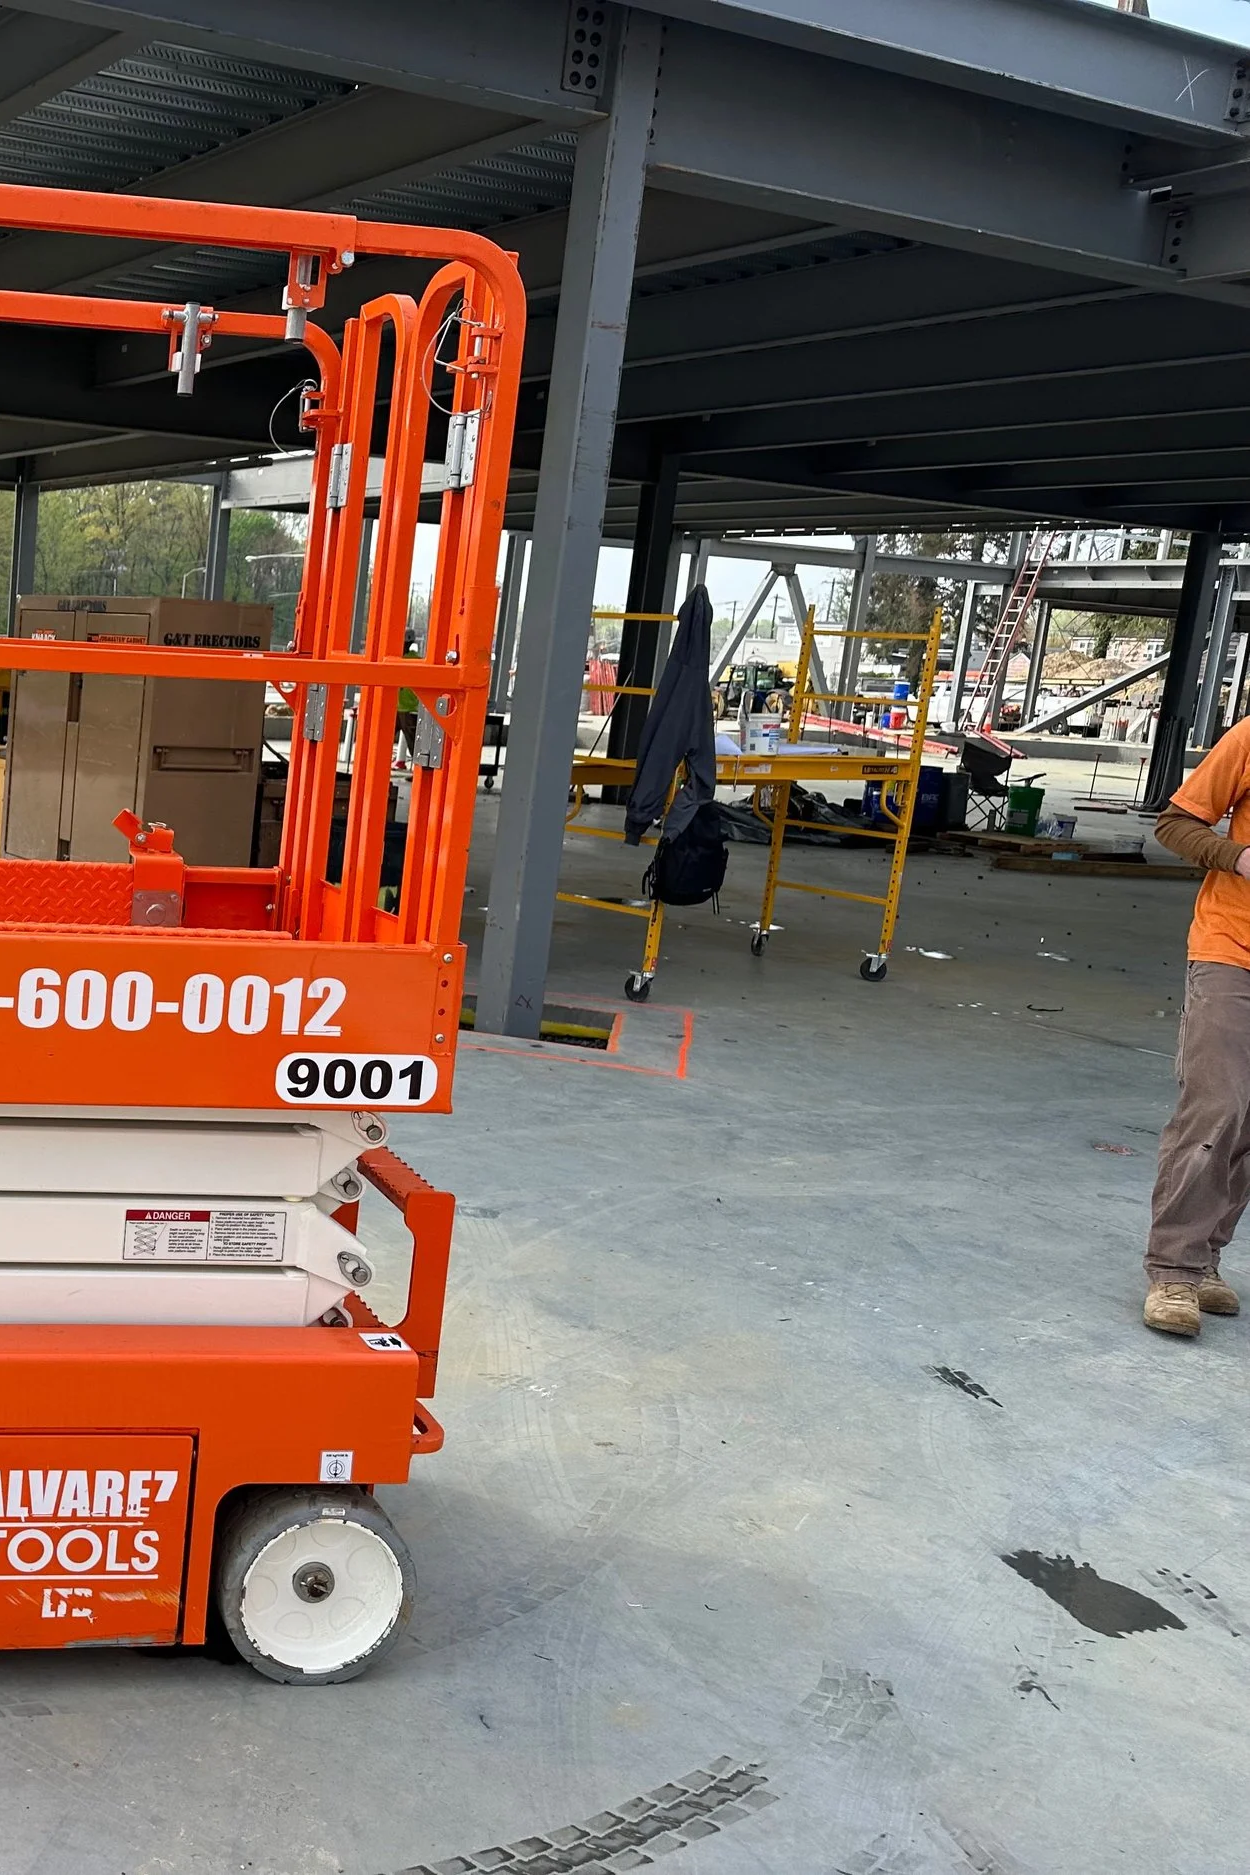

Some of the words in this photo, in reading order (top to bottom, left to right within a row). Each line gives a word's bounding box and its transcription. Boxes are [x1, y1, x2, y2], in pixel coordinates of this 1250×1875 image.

[163, 632, 191, 646] G&T
[193, 633, 261, 649] ERECTORS
[286, 1057, 424, 1100] 9001
[152, 1211, 191, 1220] DANGER
